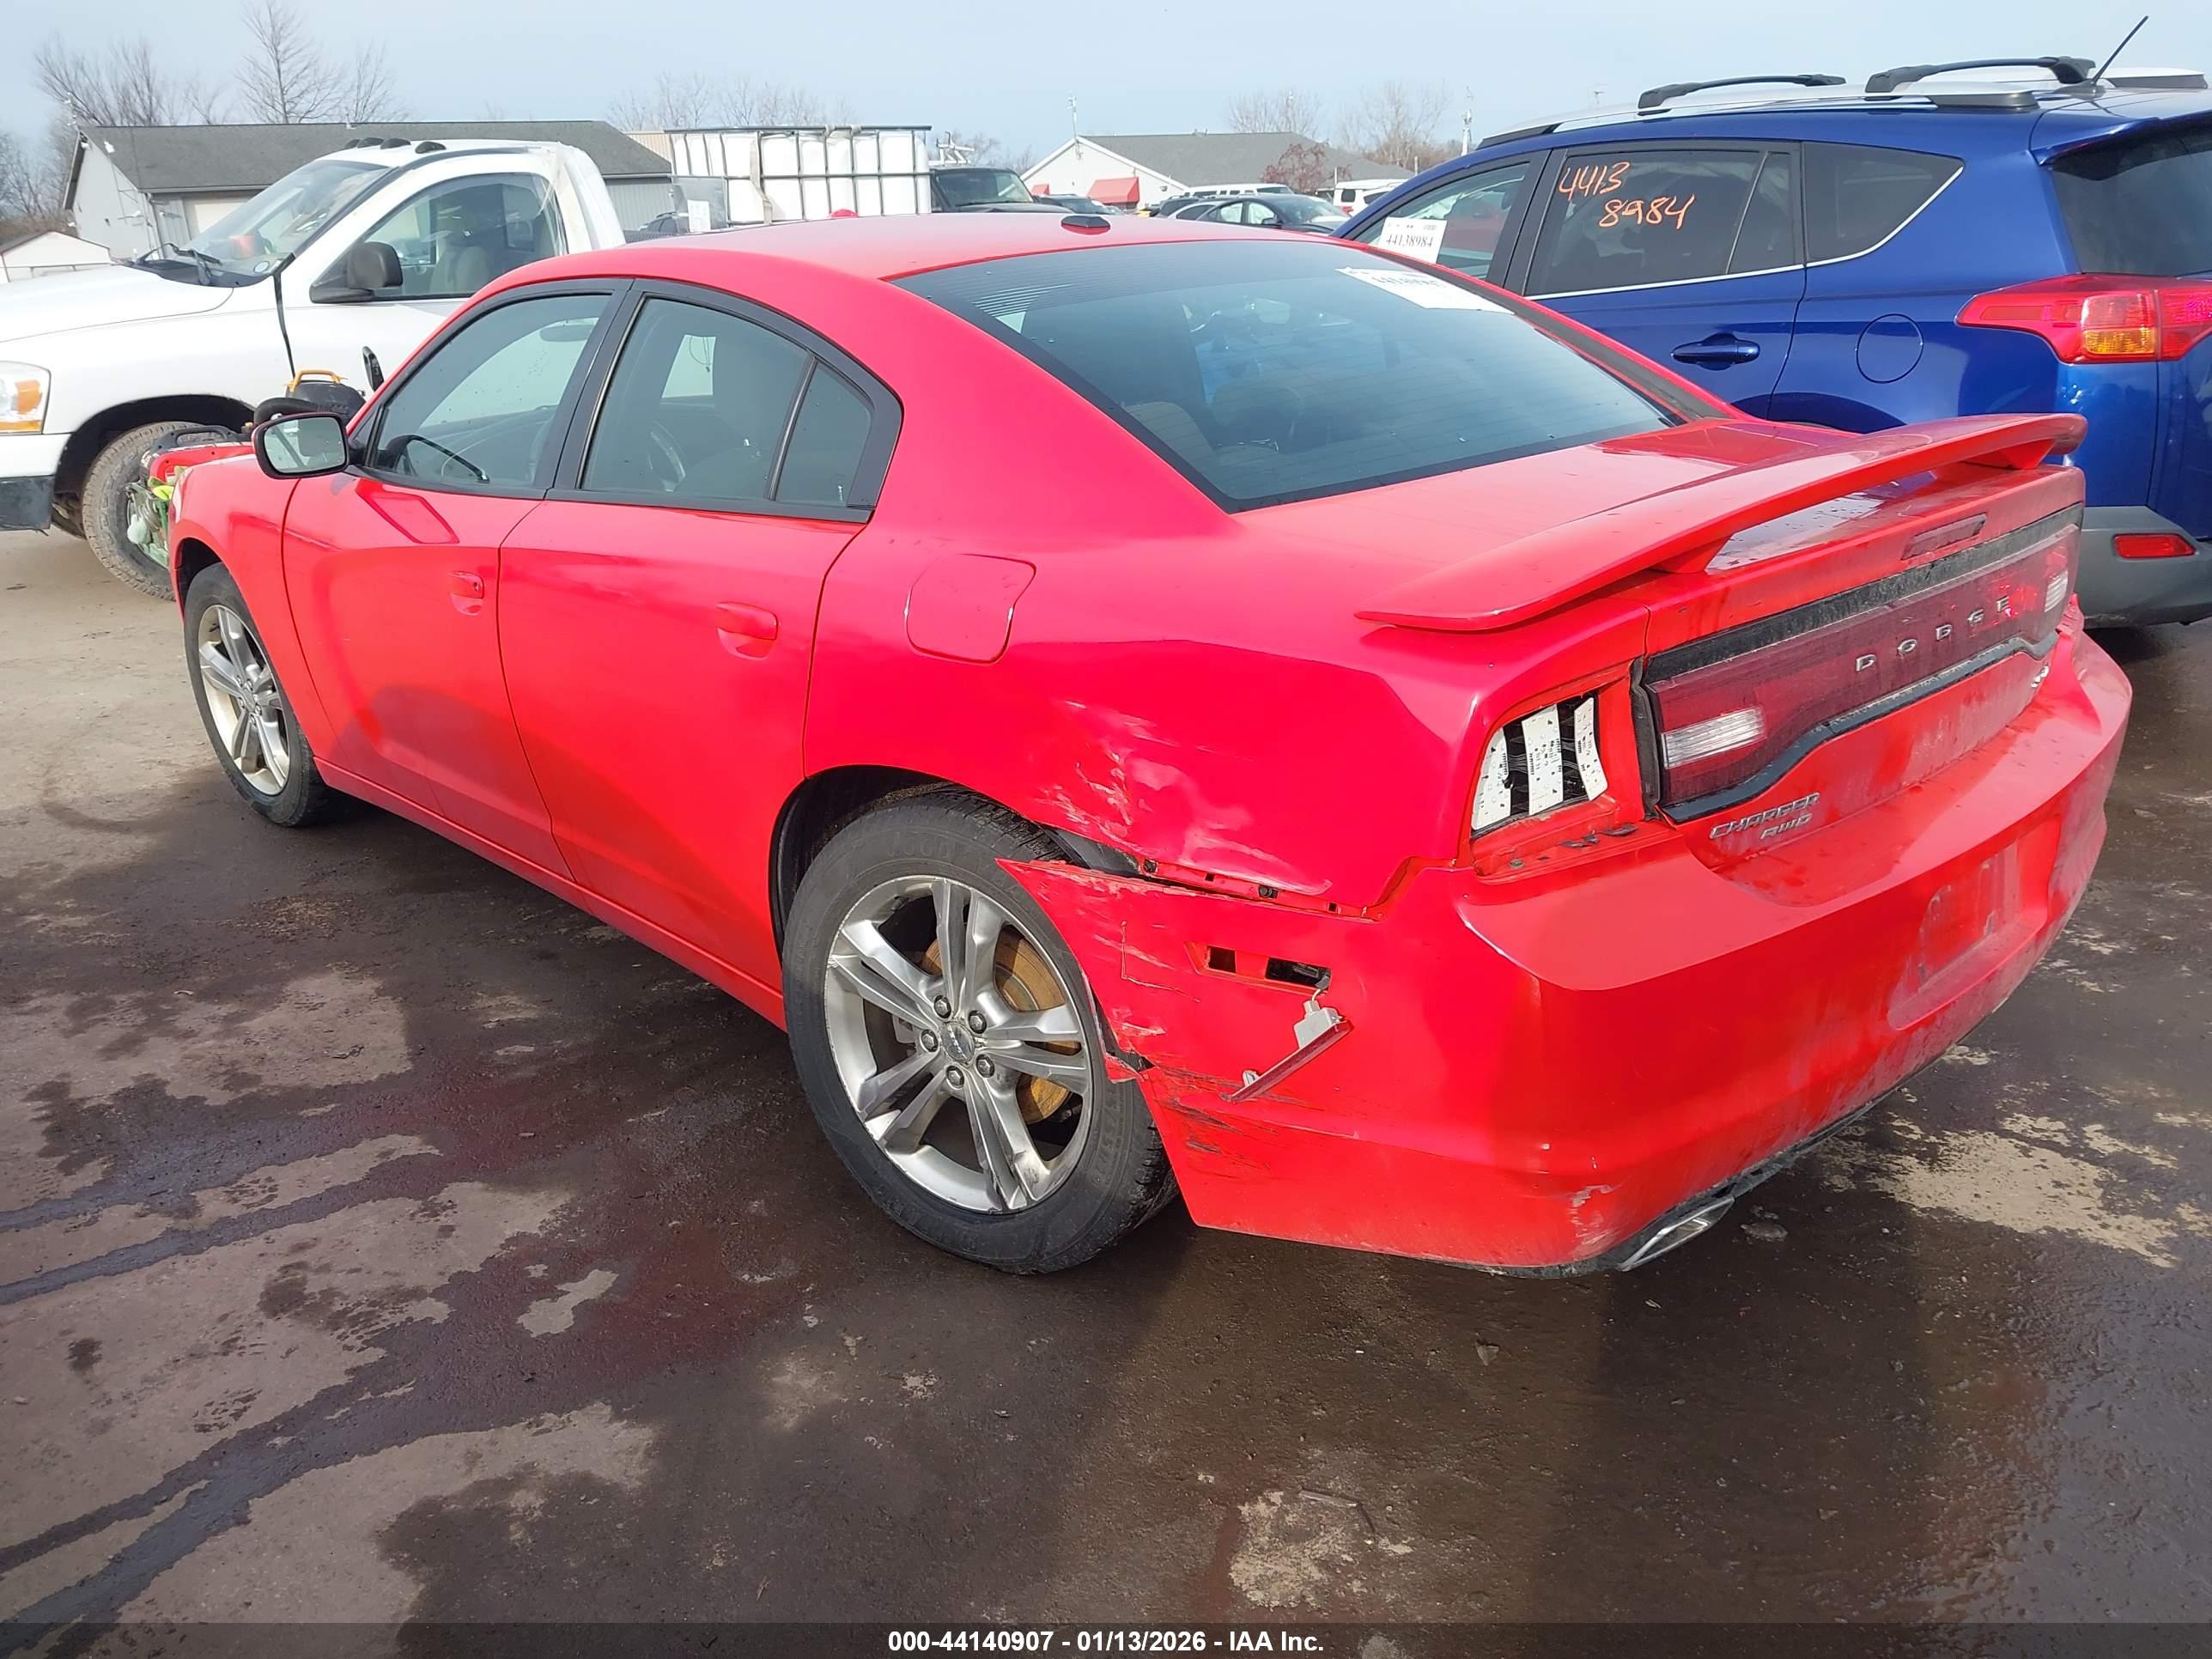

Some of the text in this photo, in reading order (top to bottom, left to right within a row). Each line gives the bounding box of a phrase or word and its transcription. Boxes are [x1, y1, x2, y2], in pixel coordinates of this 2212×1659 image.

[1559, 161, 1631, 202] 4413
[1599, 193, 1696, 230] 8984
[1385, 233, 1435, 248] 44138984
[1855, 595, 2010, 672] DODGE
[1709, 792, 1821, 840] CHARGER
[1760, 812, 1814, 840] AWD
